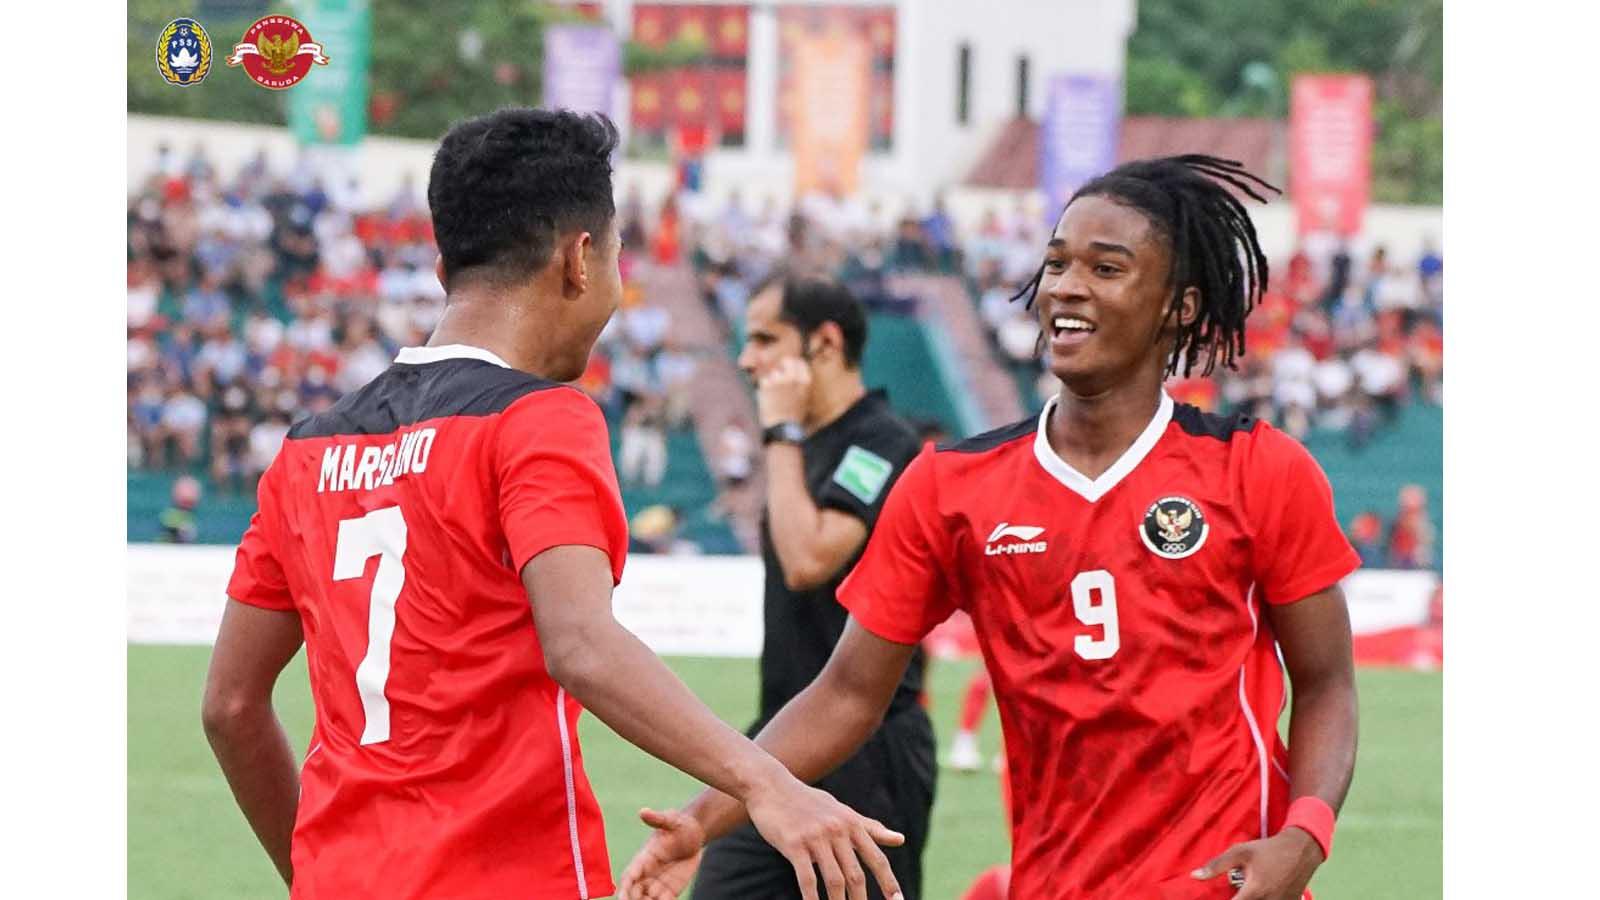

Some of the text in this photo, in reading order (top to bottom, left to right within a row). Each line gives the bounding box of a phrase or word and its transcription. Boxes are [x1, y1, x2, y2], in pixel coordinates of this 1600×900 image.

[985, 541, 1047, 555] LI-NING
[332, 505, 408, 746] 7
[1071, 569, 1120, 660] 9
